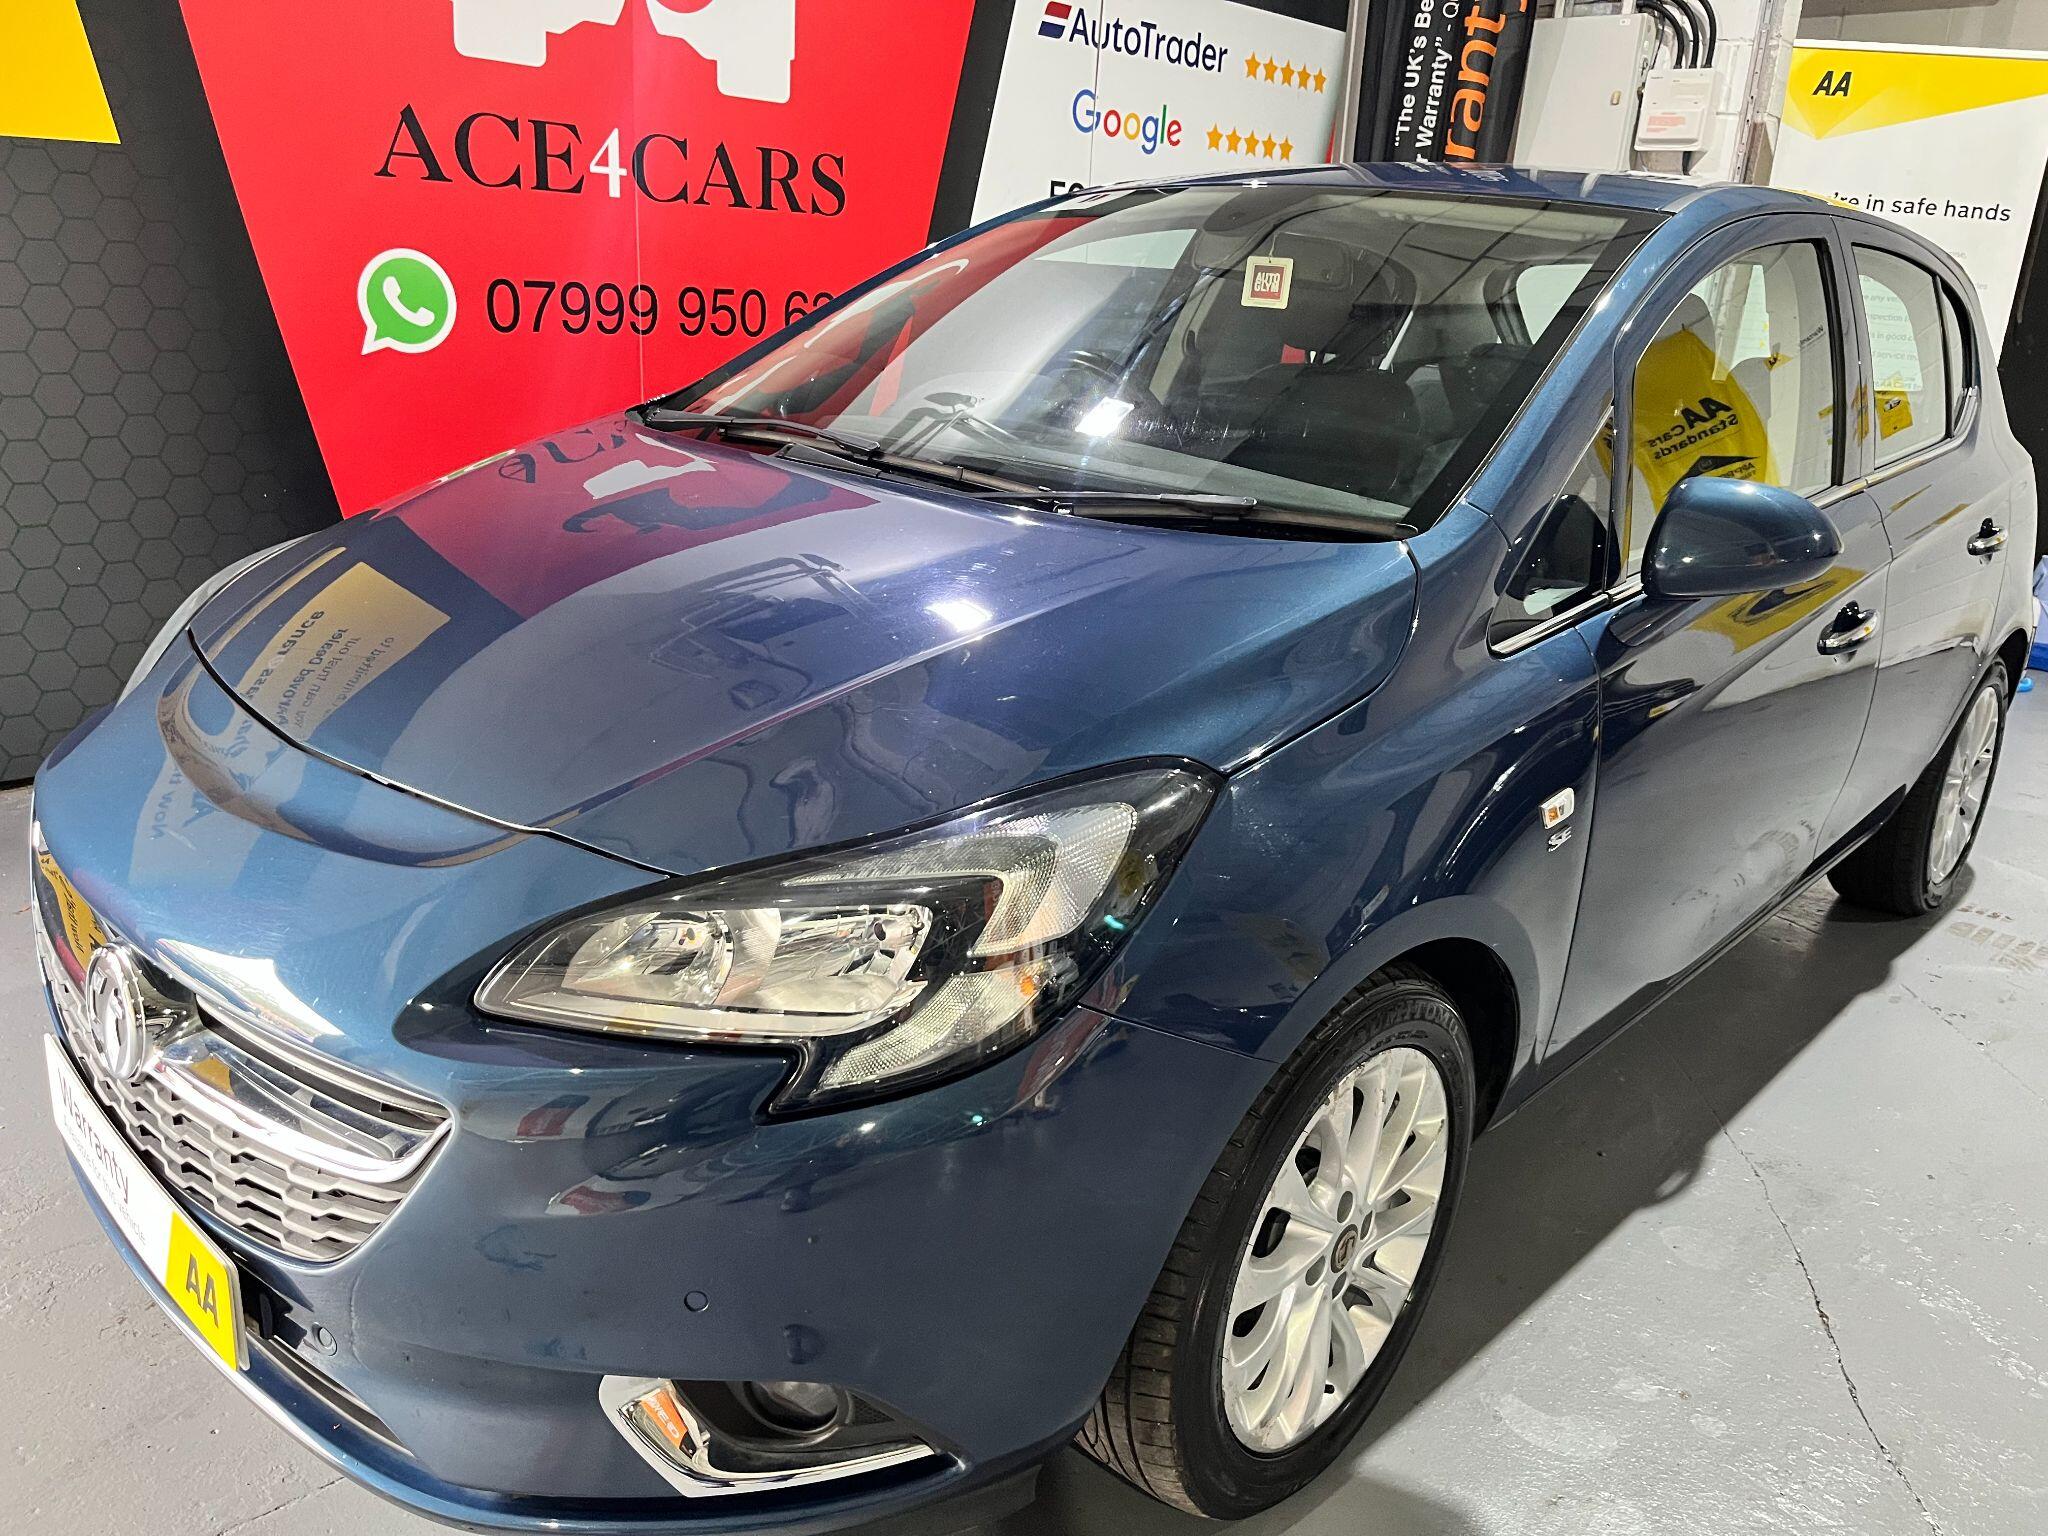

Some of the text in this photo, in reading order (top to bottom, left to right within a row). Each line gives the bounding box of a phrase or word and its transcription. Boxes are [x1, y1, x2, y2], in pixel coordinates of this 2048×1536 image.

[1069, 8, 1228, 73] AutoTrader
[1404, 35, 1428, 88] UK's
[1444, 0, 1528, 161] rant
[1812, 70, 1853, 97] AA
[1072, 88, 1182, 155] Google
[374, 103, 847, 216] ACE4CARS
[1865, 194, 1885, 213] in
[1891, 198, 1937, 216] safe
[1943, 200, 2012, 222] hands
[486, 278, 659, 335] 07999
[678, 287, 767, 337] 950
[57, 1066, 129, 1205] Warranty
[185, 1253, 219, 1330] AA
